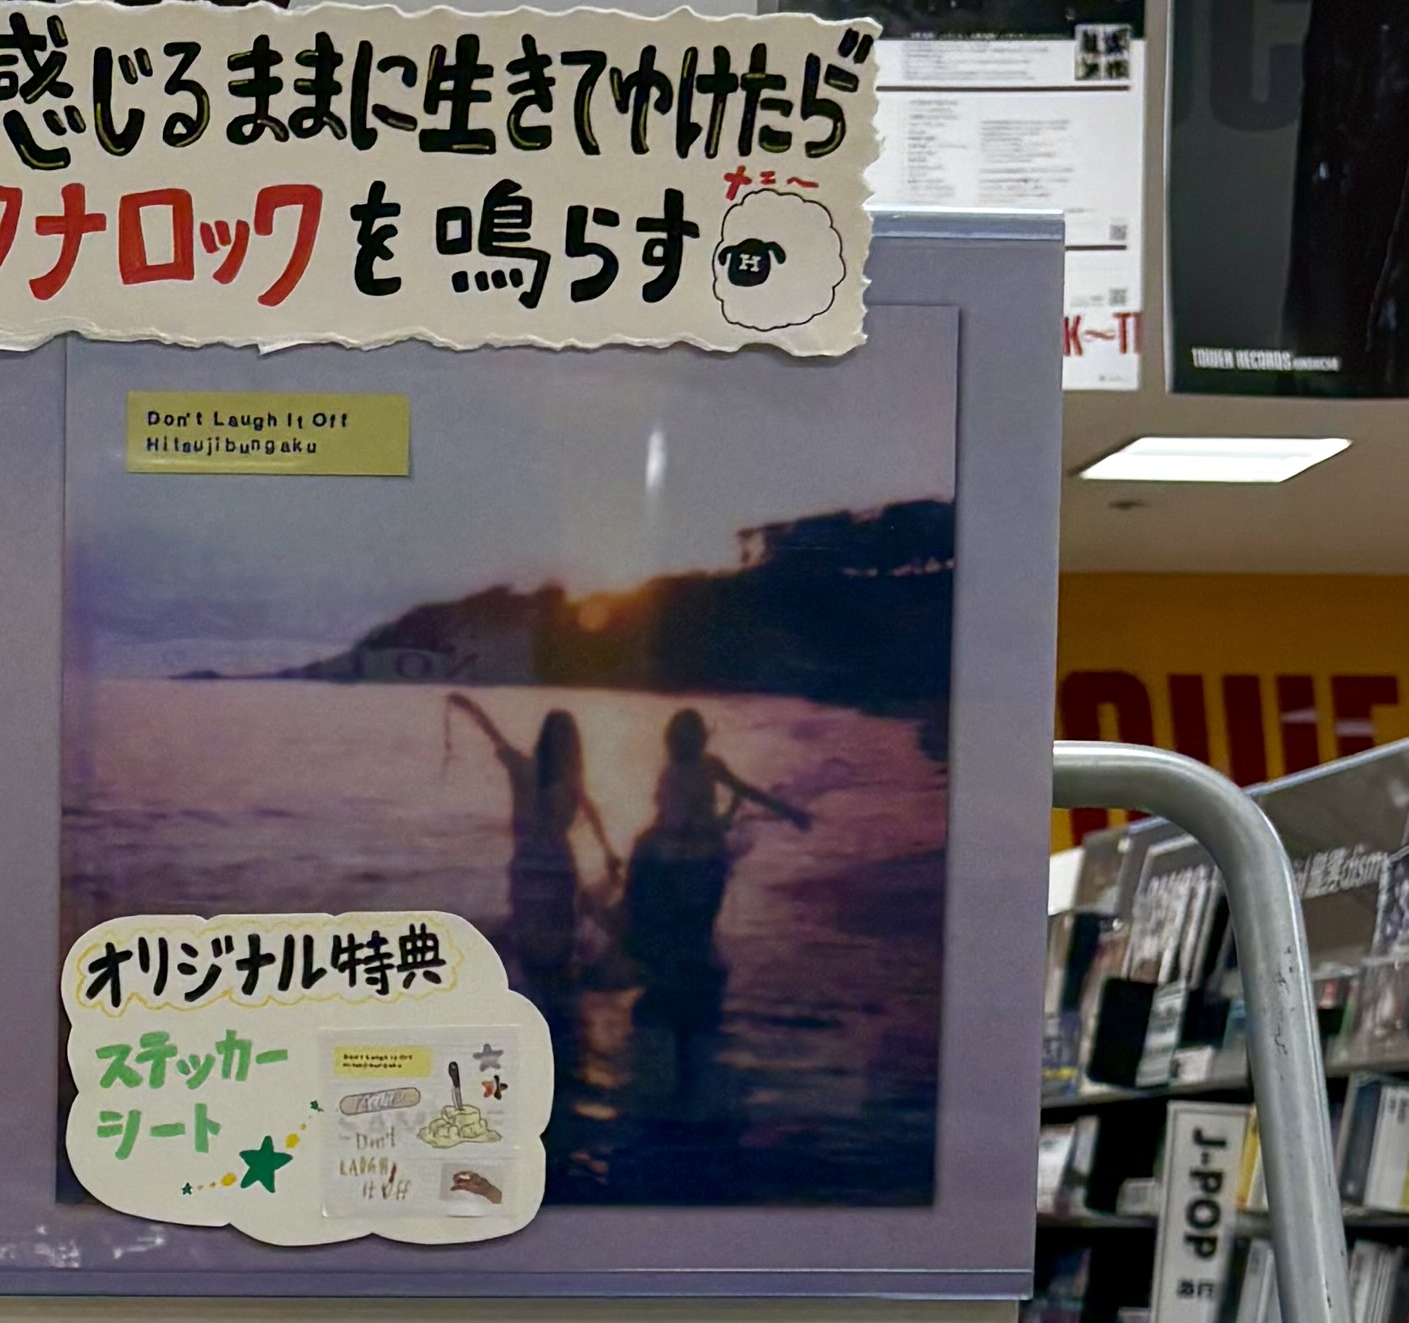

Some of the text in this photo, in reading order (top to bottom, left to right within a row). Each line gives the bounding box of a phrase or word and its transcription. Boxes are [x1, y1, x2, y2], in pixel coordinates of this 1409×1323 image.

[146, 436, 317, 456] Hitsujibungaku
[147, 411, 348, 431] Don't Laugh It Off
[86, 923, 446, 1008] オリジナル特典
[95, 1029, 288, 1090] ステッカー
[97, 1102, 221, 1161] シート
